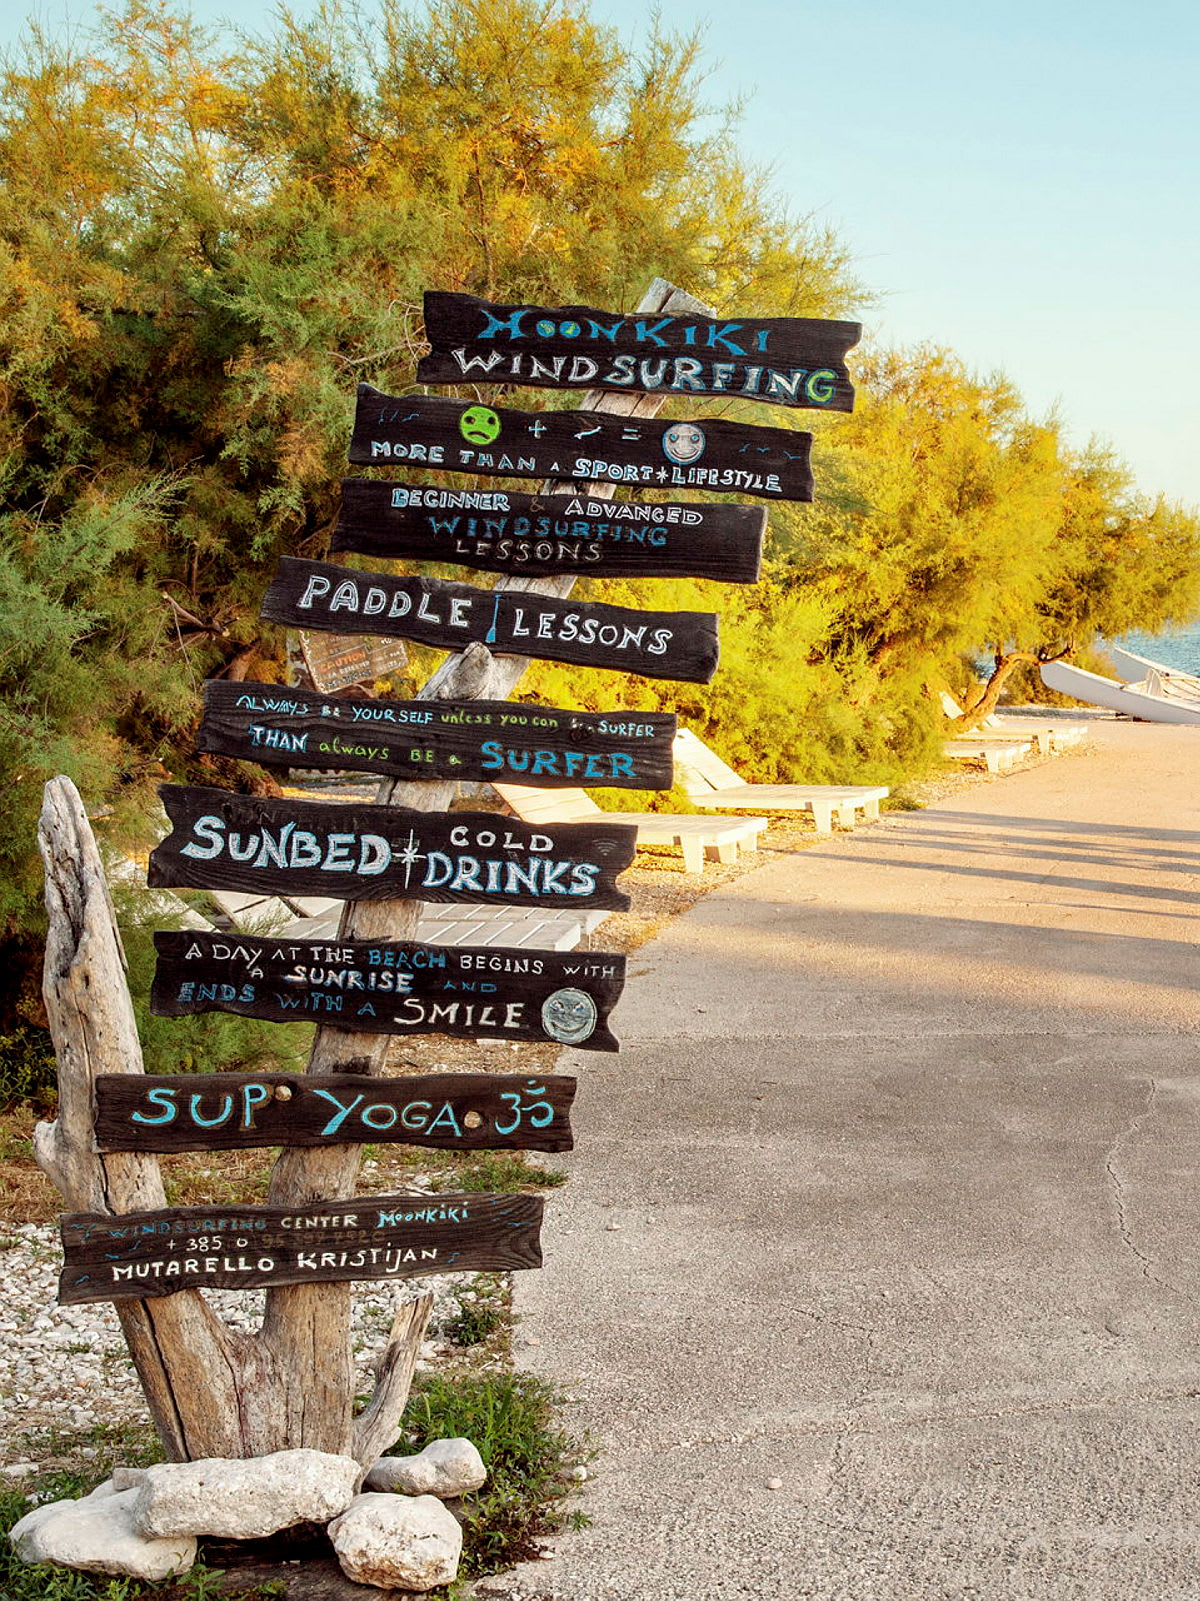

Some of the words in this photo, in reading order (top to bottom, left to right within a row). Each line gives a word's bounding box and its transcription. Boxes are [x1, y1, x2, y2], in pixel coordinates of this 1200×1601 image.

[453, 346, 838, 405] WINDSURFING
[370, 440, 445, 463] MORE
[459, 449, 536, 472] THAN
[550, 461, 560, 472] A
[391, 487, 511, 512] BEGINNER
[564, 499, 704, 525] ADVANCED
[427, 515, 669, 547] WINDSURFING
[456, 538, 603, 562] LESSONS
[296, 575, 473, 628] PADDLE
[512, 608, 673, 654] LESSONS
[319, 650, 366, 674] CAUTION
[235, 695, 310, 716] ALWAYS
[441, 710, 492, 725] unless
[500, 714, 528, 727] you
[532, 715, 559, 728] can
[598, 719, 655, 738] SURFER
[248, 724, 310, 753] THAN
[319, 736, 389, 760] always
[411, 749, 434, 762] BE
[480, 741, 637, 779] SURFER
[179, 815, 392, 875] SUNBED
[421, 851, 601, 896] DRINKS
[450, 825, 554, 852] COLD
[185, 943, 202, 960] A
[212, 944, 262, 969] DAY
[271, 947, 302, 961] AT
[311, 946, 355, 964] THE
[369, 949, 446, 969] BEACH
[460, 955, 544, 975] BEGINS
[563, 964, 616, 979] WITH
[251, 966, 264, 979] A
[283, 964, 415, 994] SUNRISE
[444, 980, 498, 993] AND
[178, 982, 256, 1002] ENDS
[275, 992, 343, 1012] WITH
[357, 1002, 376, 1016] A
[393, 998, 527, 1028] SMILE
[131, 1083, 270, 1129] SUP
[313, 1089, 462, 1137] YOGA
[107, 1218, 267, 1238] WINDSURFING
[280, 1214, 359, 1230] CENTER
[112, 1257, 274, 1281] MUTARELLO
